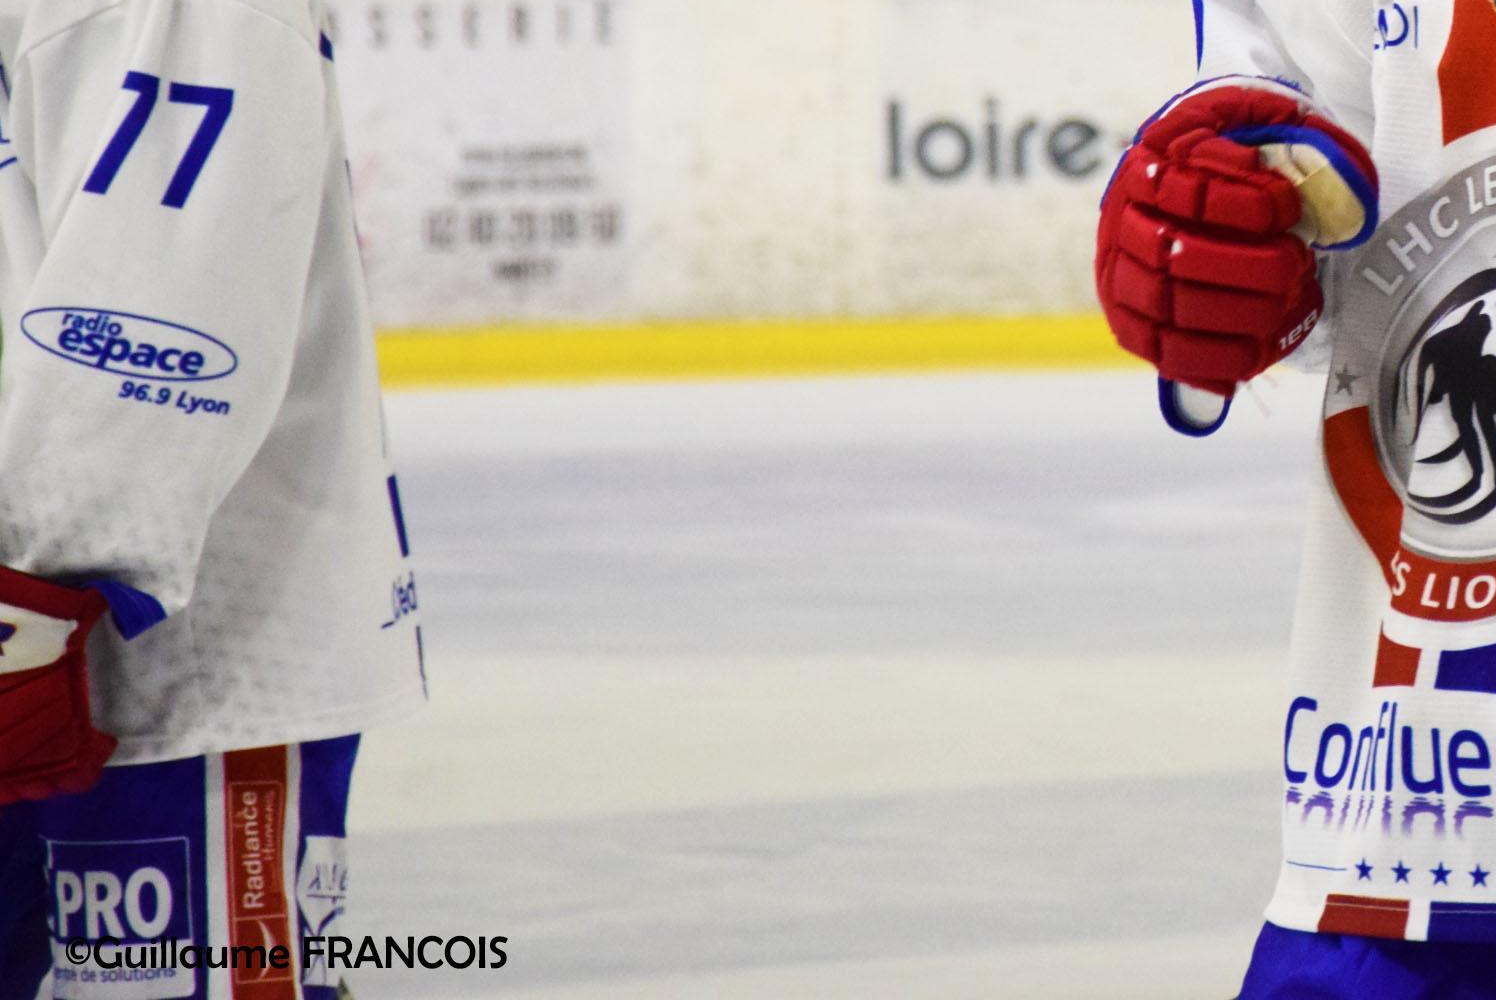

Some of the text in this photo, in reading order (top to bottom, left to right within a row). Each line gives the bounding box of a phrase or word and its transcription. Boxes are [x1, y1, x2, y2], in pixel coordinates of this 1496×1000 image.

[83, 71, 235, 209] 77
[1363, 197, 1460, 297] LHC
[57, 327, 206, 376] espace
[61, 311, 123, 340] radio
[118, 380, 231, 416] 96.9 Lyon
[242, 790, 266, 910] Radiance
[55, 866, 173, 939] PRO
